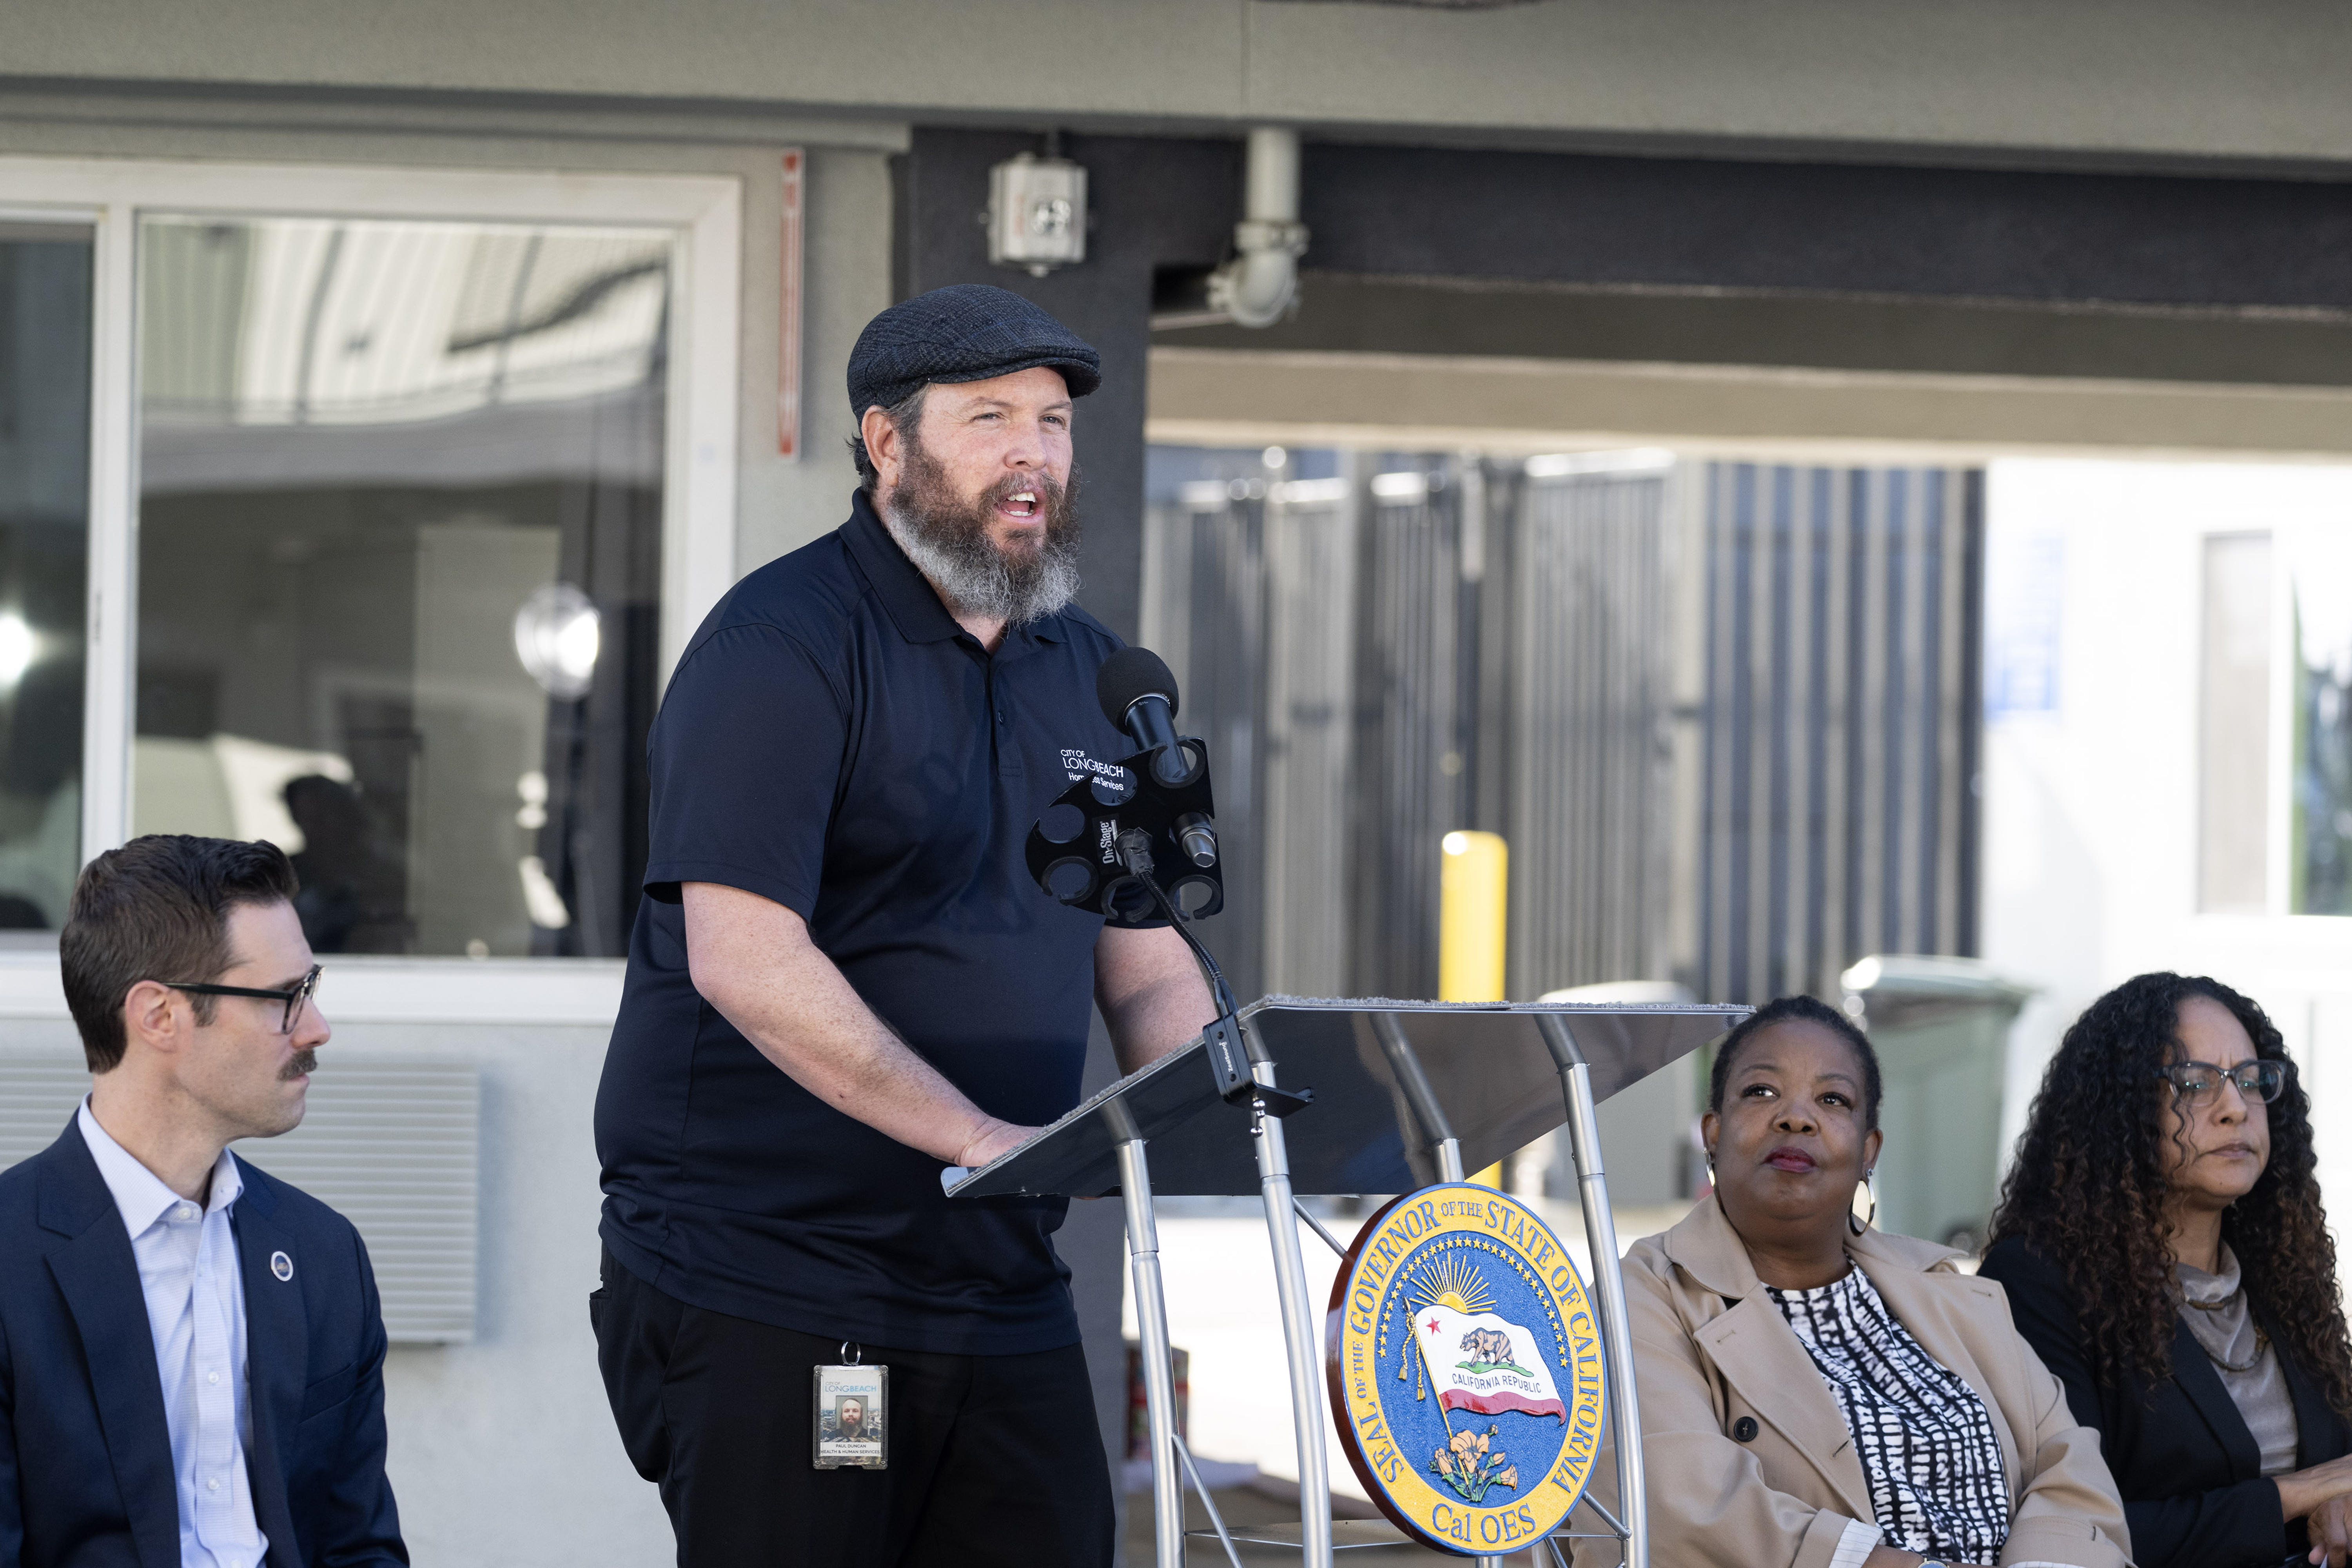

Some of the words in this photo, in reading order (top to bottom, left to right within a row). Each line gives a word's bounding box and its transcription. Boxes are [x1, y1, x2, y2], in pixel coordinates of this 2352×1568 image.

[1100, 777, 1124, 790] Services
[1441, 1201, 1456, 1216] OF
[1457, 1201, 1483, 1218] THE
[1485, 1201, 1555, 1271] STATE
[1350, 1201, 1441, 1334] GOVERNOR
[1552, 1265, 1581, 1306] OF
[1352, 1341, 1364, 1374] THE
[1355, 1378, 1367, 1398] OF
[1452, 1373, 1500, 1390] CALIFORNIA
[1502, 1375, 1541, 1393] REPUBLIC
[1551, 1312, 1599, 1493] CALIFORNIA
[1357, 1401, 1404, 1483] SEAL
[1432, 1503, 1472, 1542] Cal
[1481, 1503, 1535, 1543] OES
